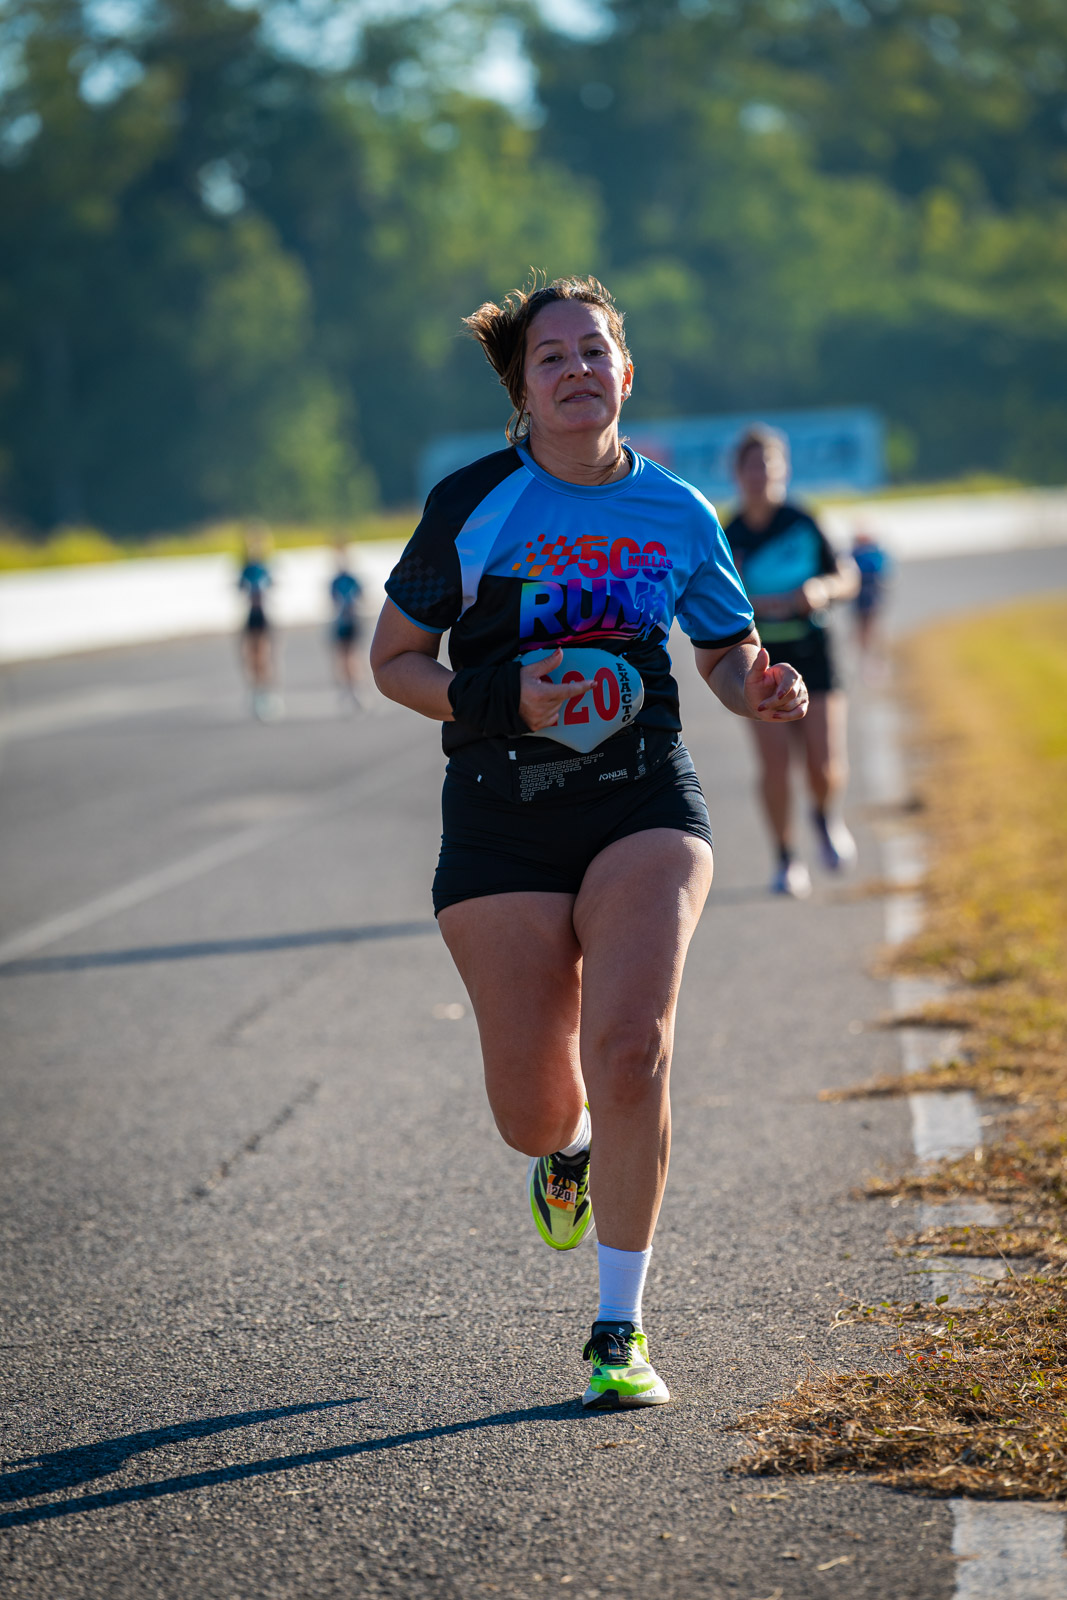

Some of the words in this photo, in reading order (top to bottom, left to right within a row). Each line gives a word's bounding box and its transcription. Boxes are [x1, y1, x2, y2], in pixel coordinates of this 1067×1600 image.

[628, 554, 673, 570] MILLAS
[519, 578, 652, 639] RUN
[540, 667, 620, 727] 20
[616, 662, 632, 723] EXACTO
[551, 1186, 571, 1201] 220
